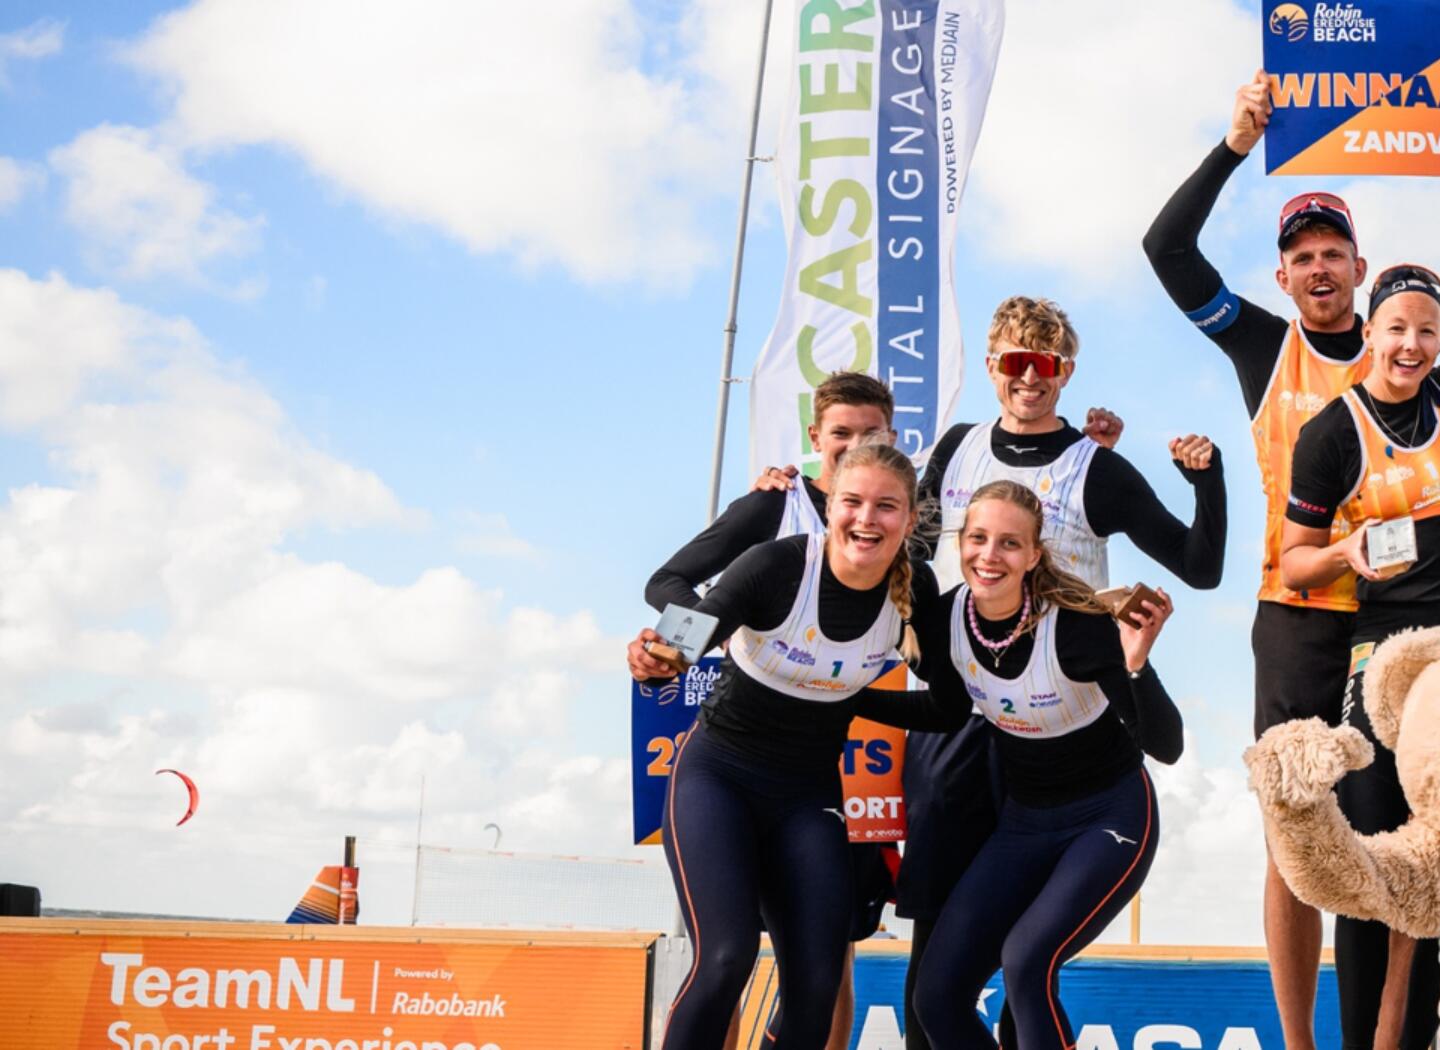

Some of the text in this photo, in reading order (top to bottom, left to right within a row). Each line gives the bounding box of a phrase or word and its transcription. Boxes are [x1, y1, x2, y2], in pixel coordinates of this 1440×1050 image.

[1314, 2, 1362, 20] Robijn
[1314, 18, 1376, 28] EREDIVISIE
[1314, 27, 1376, 42] BEACH
[941, 12, 961, 214] POWERED BY MEDIAIN
[888, 9, 925, 456] GITAL SIGNAGE
[686, 665, 722, 682] Rob
[831, 660, 843, 678] 1
[1000, 698, 1016, 714] 2
[100, 953, 355, 1012] TeamNL
[394, 967, 454, 981] Powered by
[392, 991, 506, 1017] Rabobank
